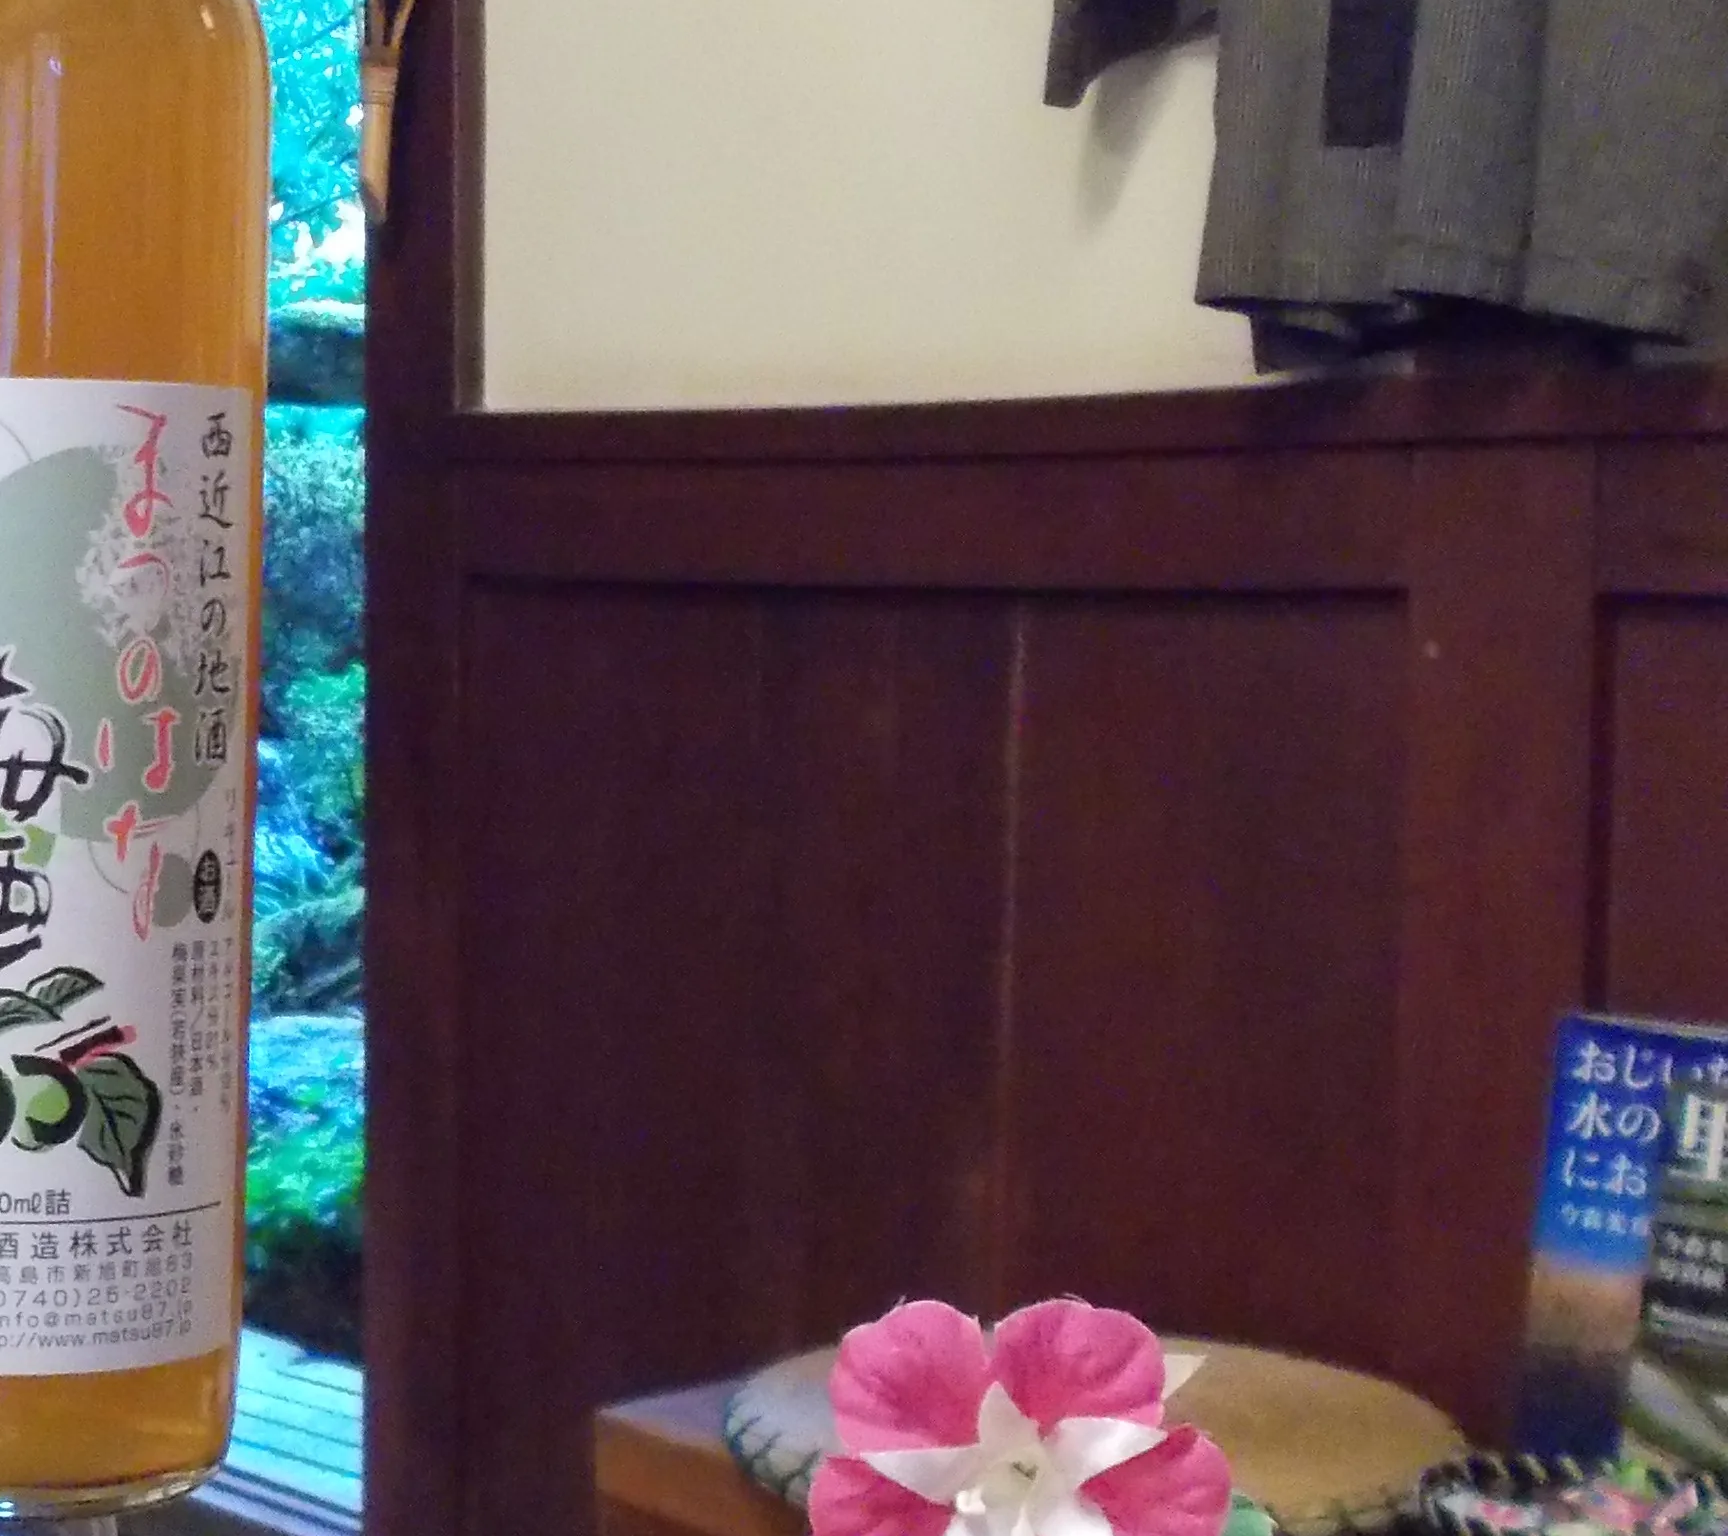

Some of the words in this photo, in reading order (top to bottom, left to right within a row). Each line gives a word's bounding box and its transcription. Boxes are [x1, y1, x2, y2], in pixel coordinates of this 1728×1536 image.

[193, 411, 235, 764] 西近江の地酒
